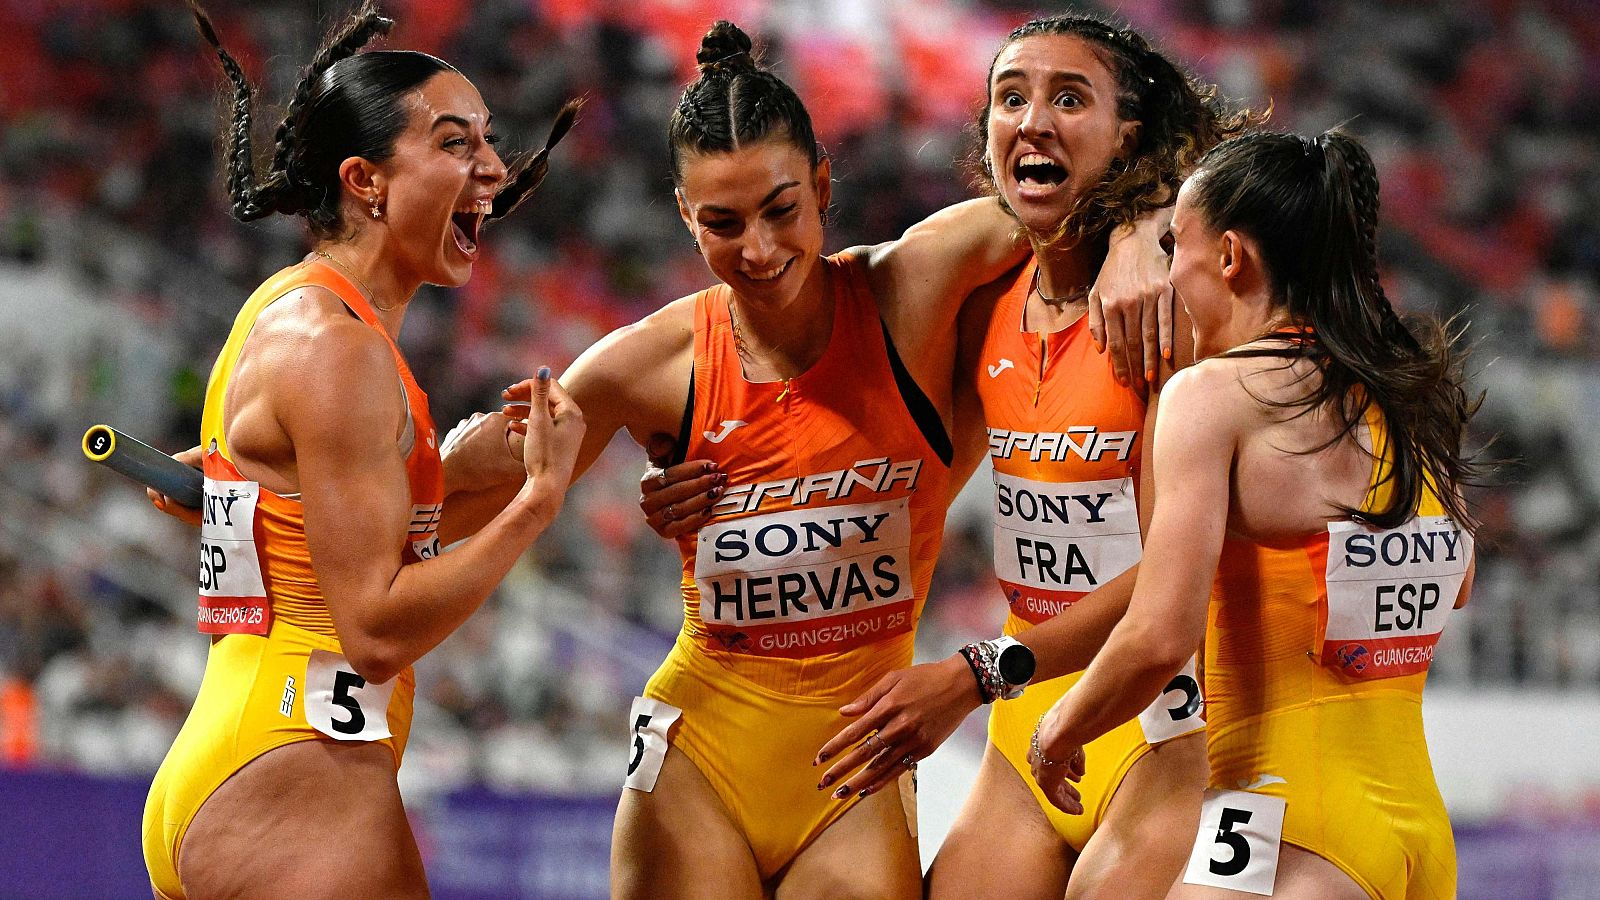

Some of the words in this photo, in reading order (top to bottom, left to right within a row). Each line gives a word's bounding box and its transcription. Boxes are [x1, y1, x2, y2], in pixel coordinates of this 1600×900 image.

[94, 436, 106, 450] 5
[986, 425, 1137, 462] SPAÑA
[712, 456, 923, 516] SPAÑA
[997, 484, 1113, 525] SONY
[714, 512, 890, 563] SONY
[1344, 529, 1462, 568] SONY
[1015, 536, 1098, 586] FRA
[712, 554, 900, 621] HERVAS
[1374, 582, 1440, 632] ESP
[247, 606, 264, 624] 25
[758, 615, 883, 651] GUANGZHOU
[886, 610, 907, 630] 25
[1373, 644, 1434, 667] GUANGZHO
[279, 675, 297, 718] ESP
[331, 670, 367, 735] 5
[626, 713, 653, 777] 5
[1209, 807, 1253, 876] 5
